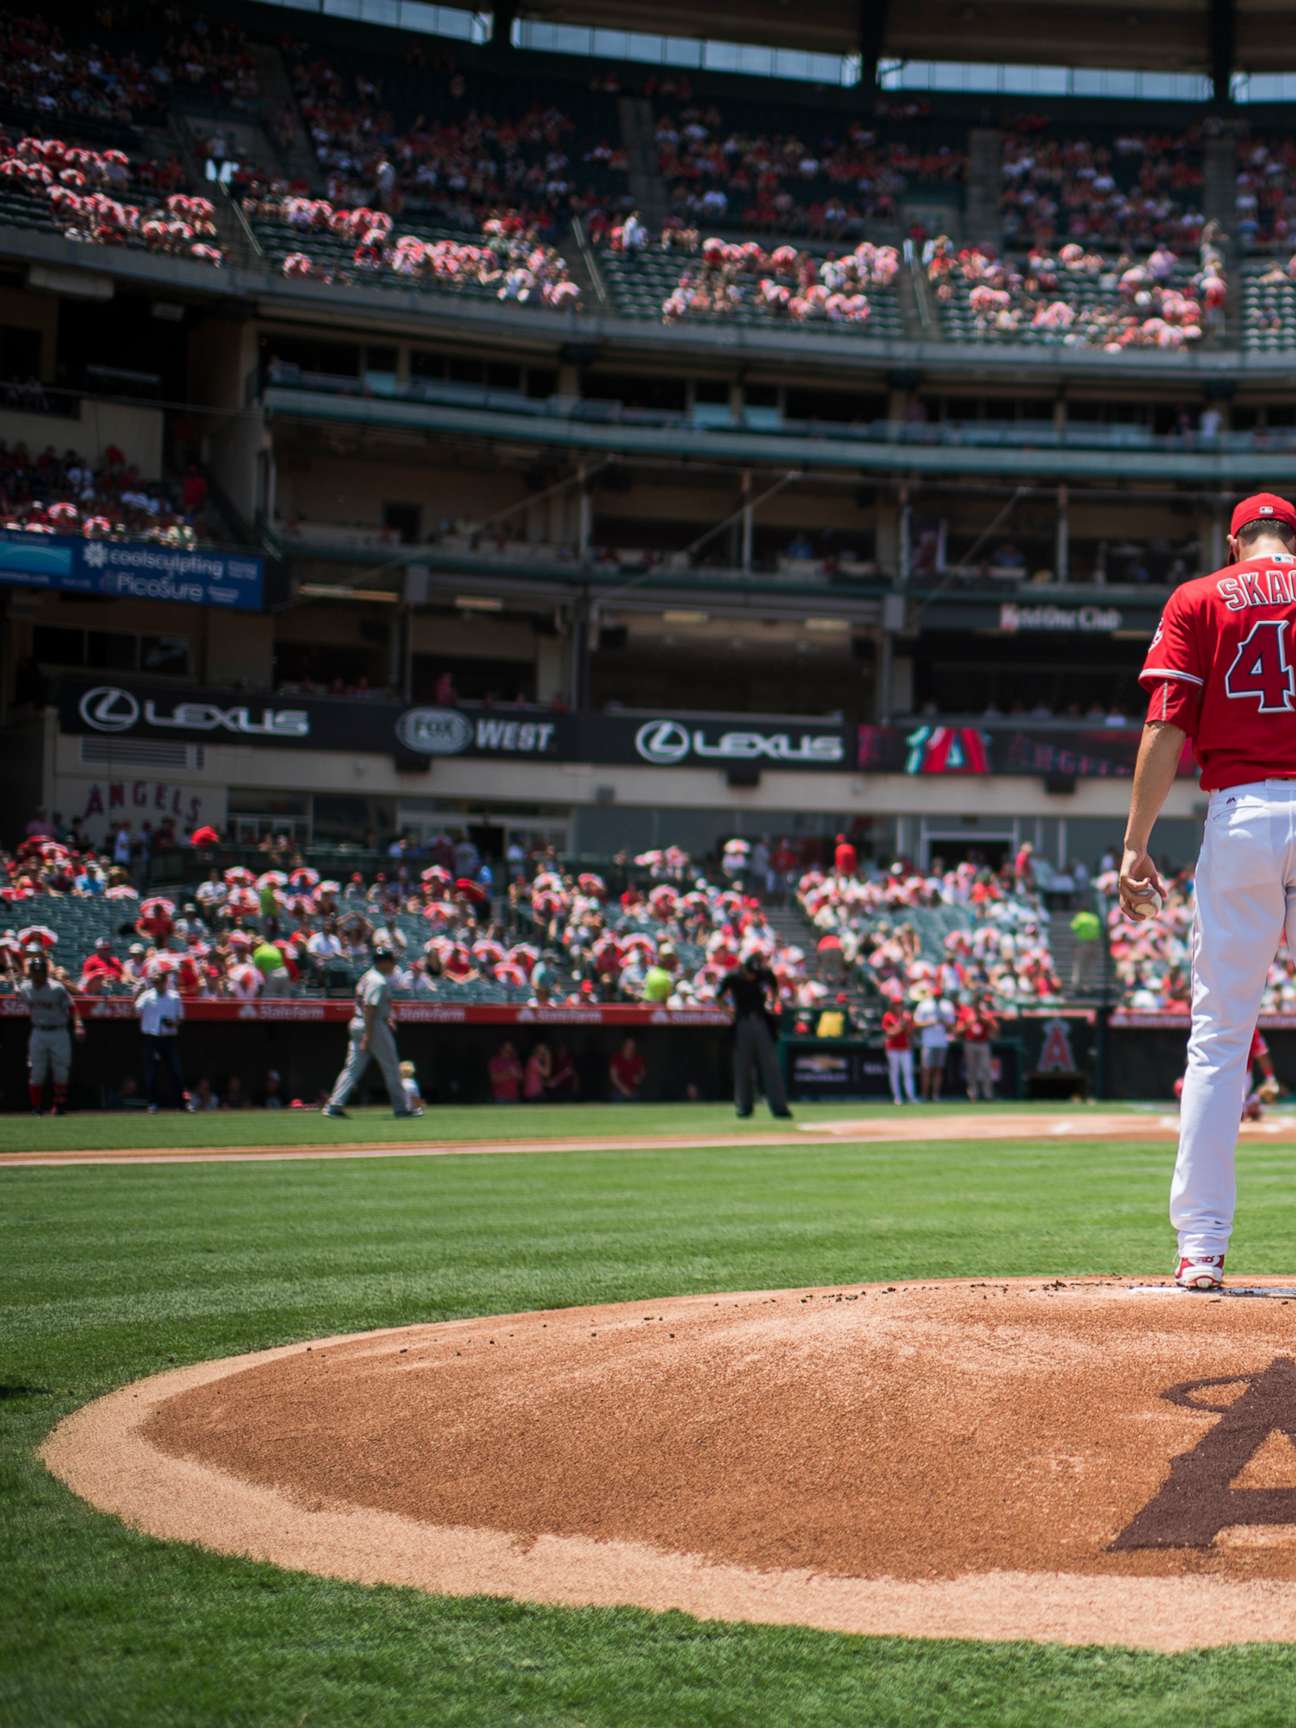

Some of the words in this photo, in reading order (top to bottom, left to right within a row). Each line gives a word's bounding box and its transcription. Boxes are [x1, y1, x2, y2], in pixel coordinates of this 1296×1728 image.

[145, 700, 310, 736] LEXUS
[475, 718, 554, 752] WEST
[693, 731, 844, 760] LEXUS
[81, 781, 203, 822] ANGELS
